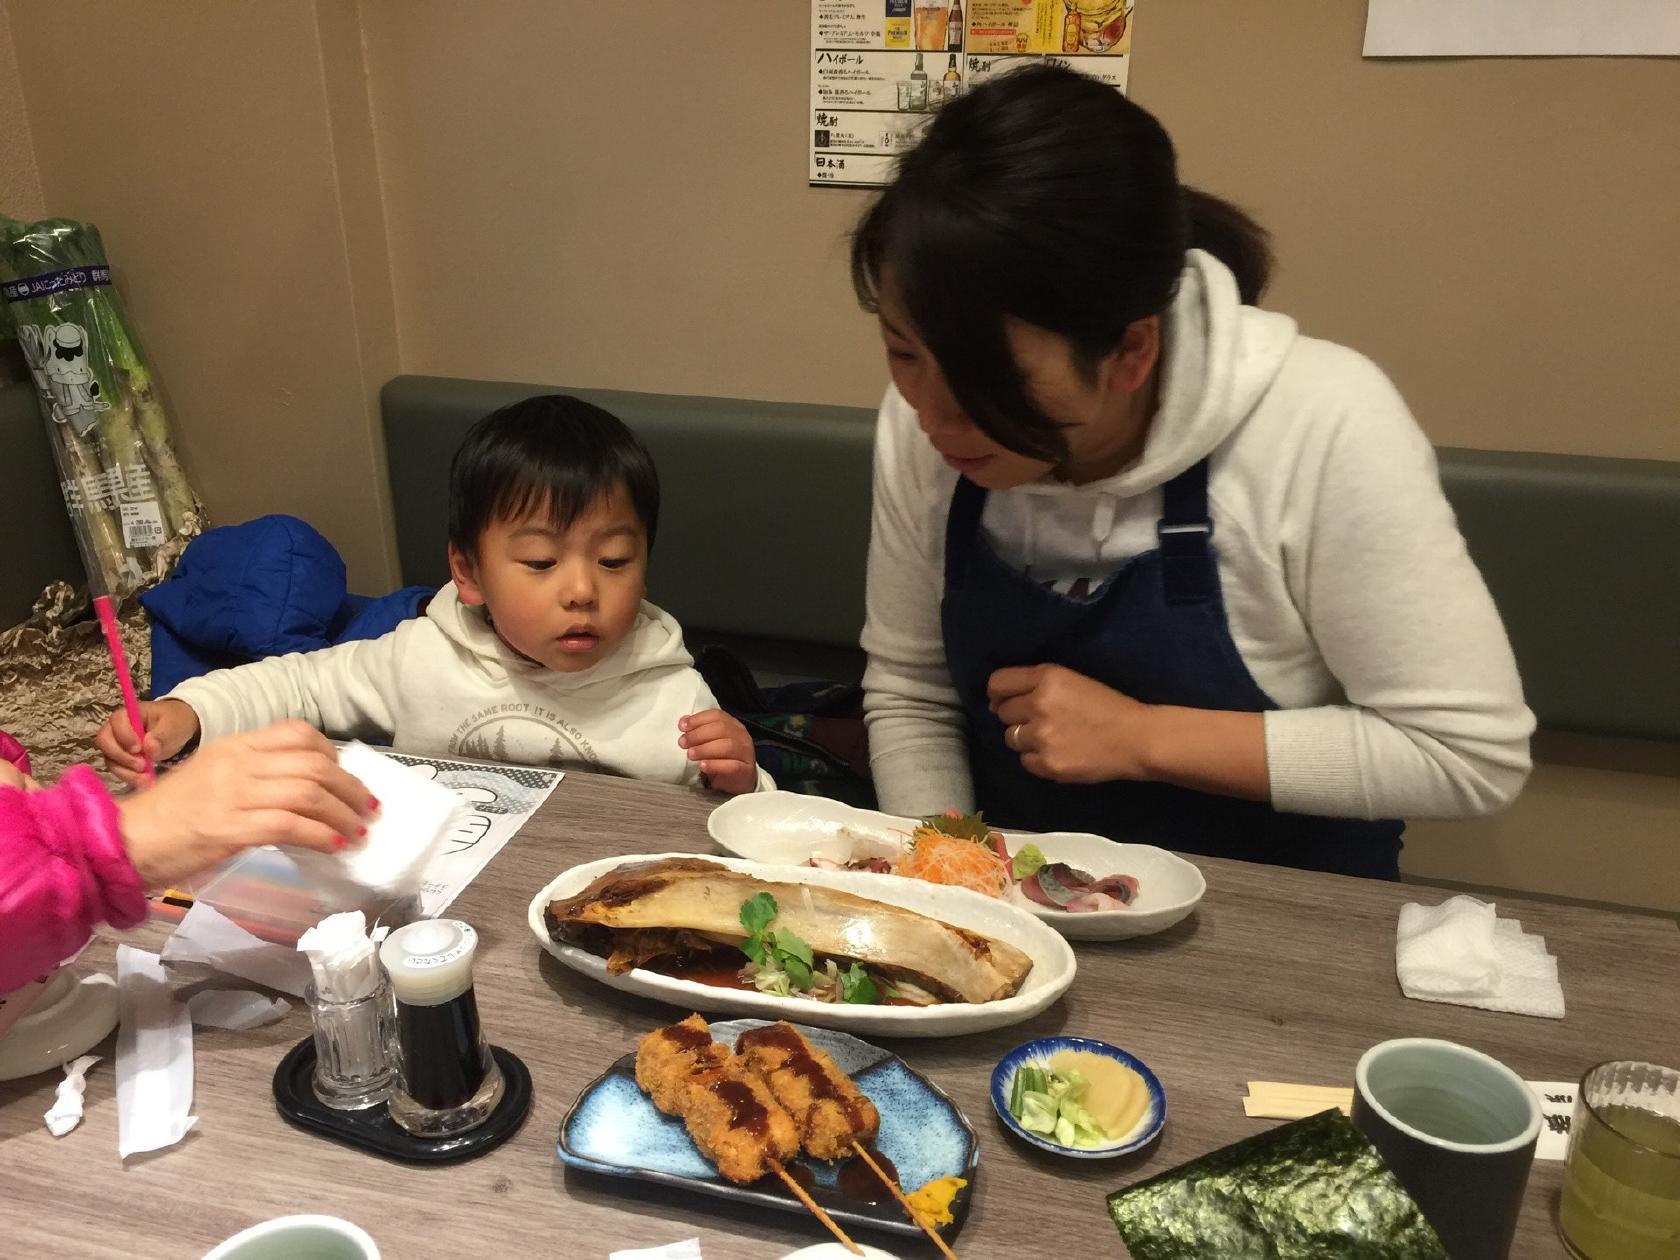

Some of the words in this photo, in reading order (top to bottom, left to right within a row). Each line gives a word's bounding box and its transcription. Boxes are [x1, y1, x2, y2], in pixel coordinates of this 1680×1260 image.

[817, 52, 864, 65] ハイボール
[816, 157, 845, 170] 日本酒
[456, 717, 472, 735] THE
[471, 705, 499, 723] SAME
[500, 703, 530, 713] ROOT
[534, 706, 545, 716] IT
[545, 711, 556, 721] IS
[556, 719, 583, 740] ALSO
[580, 739, 600, 764] KNO
